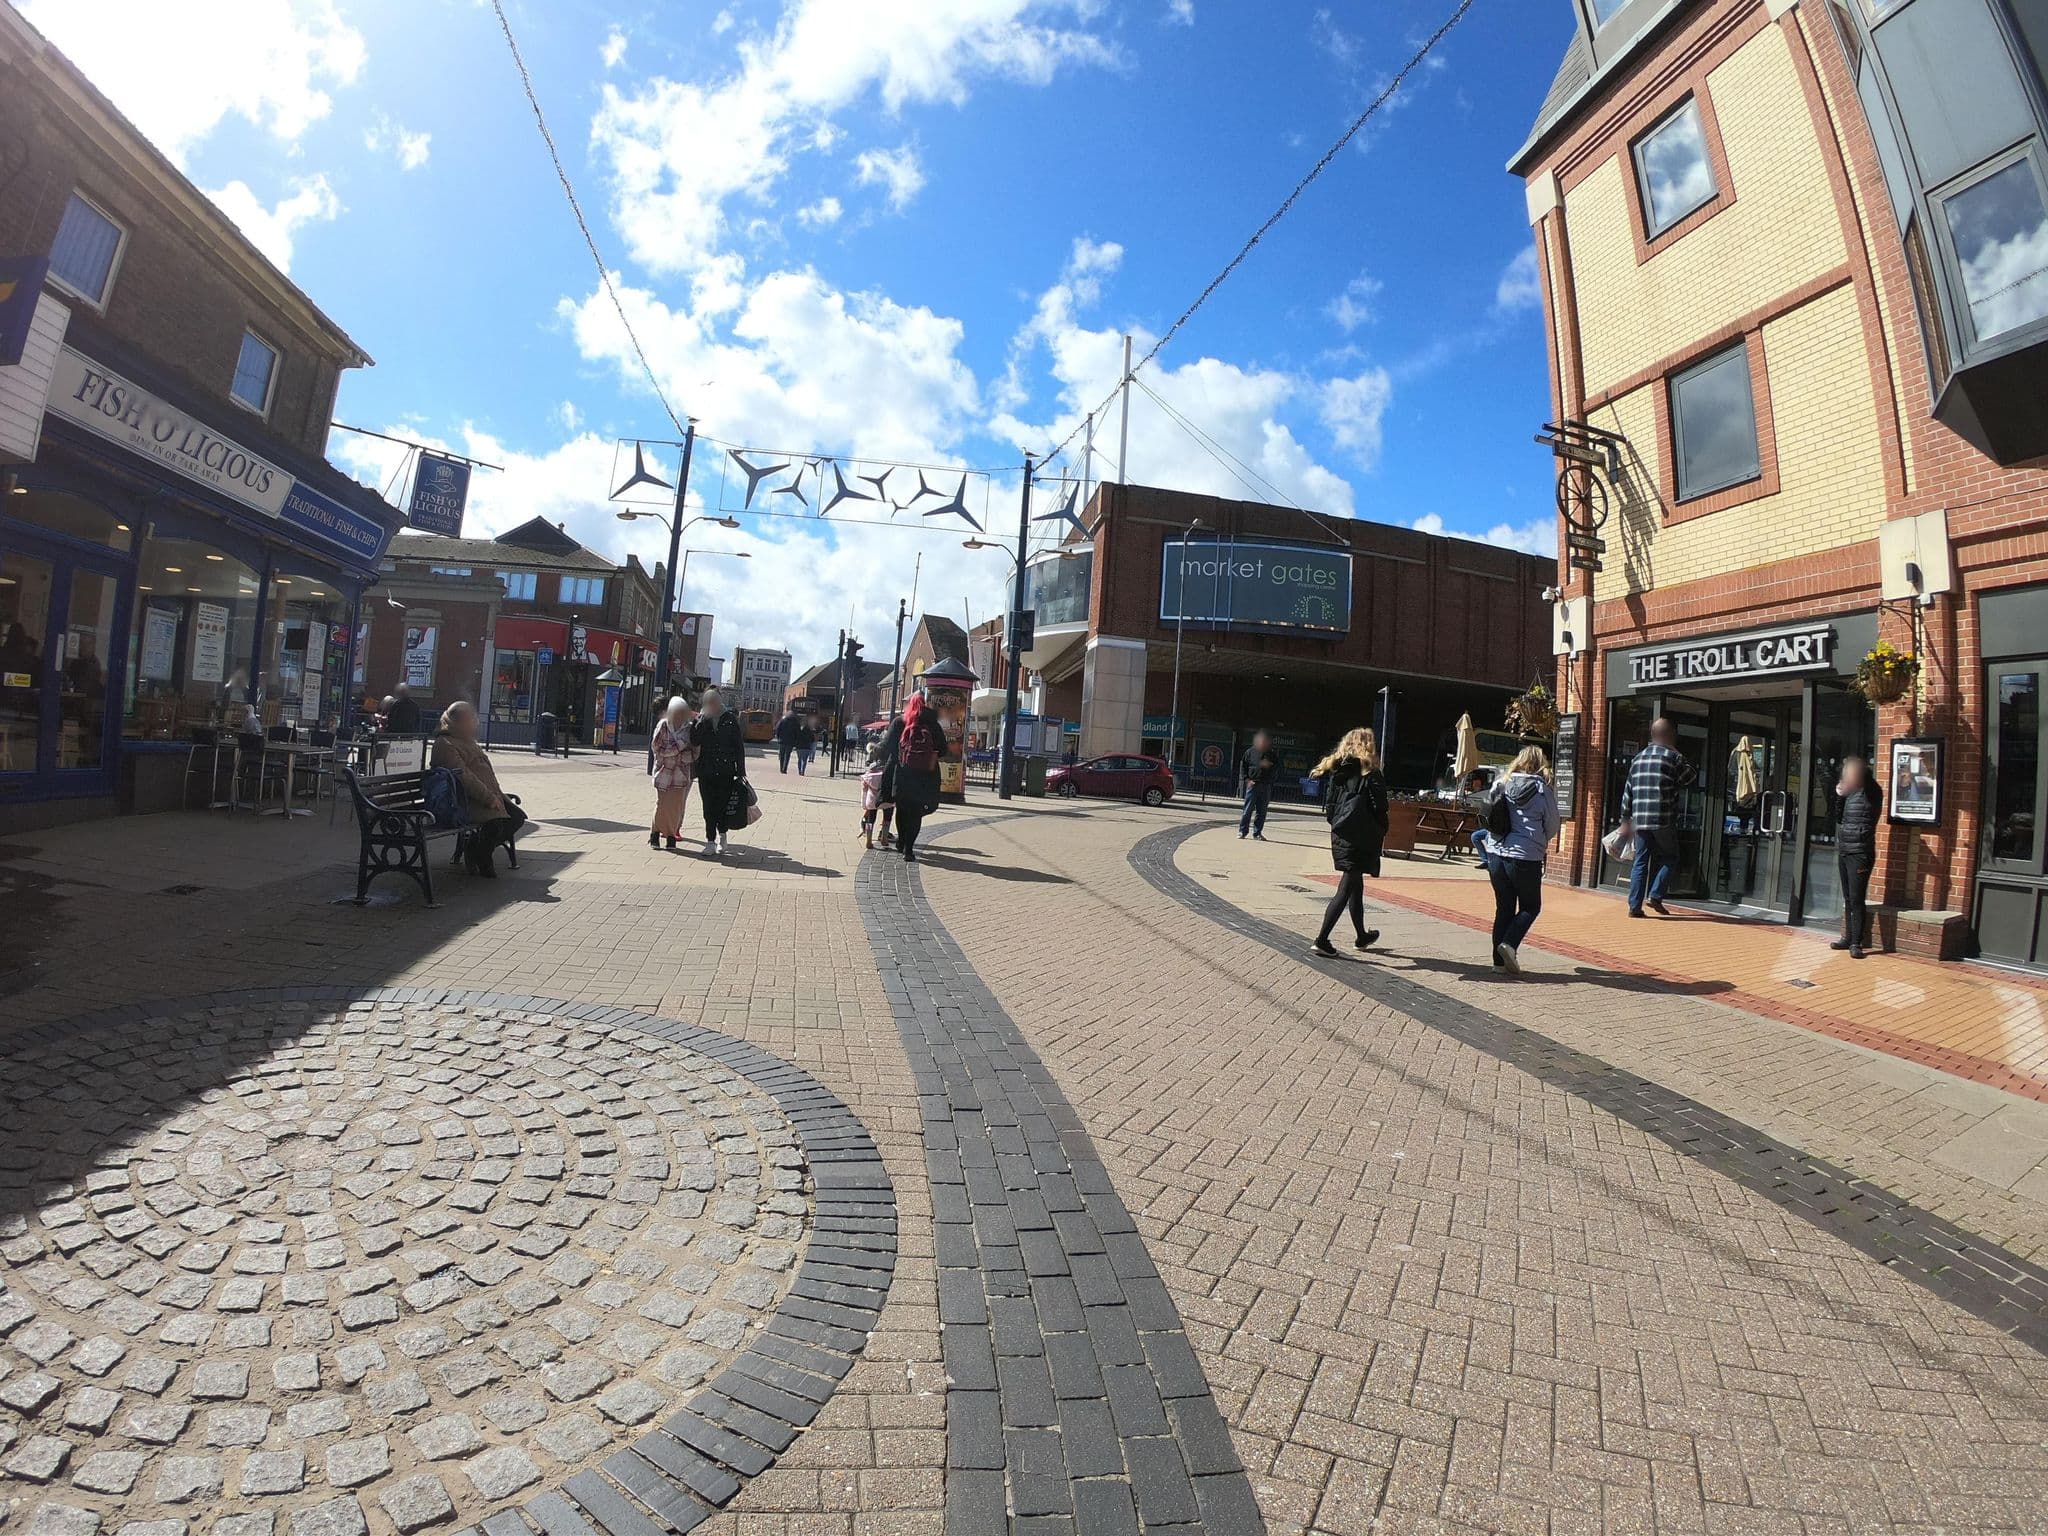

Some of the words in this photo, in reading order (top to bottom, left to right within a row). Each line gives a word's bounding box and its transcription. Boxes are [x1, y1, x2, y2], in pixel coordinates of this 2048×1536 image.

[287, 495, 335, 527] TRADITIONAL
[335, 519, 353, 536] FISH
[357, 530, 377, 548] CHIPS
[414, 500, 461, 519] LICIOUS
[1179, 557, 1264, 579] market
[1271, 564, 1337, 586] gates
[1629, 655, 1668, 681] THE
[1674, 644, 1750, 676] TROLL
[1755, 632, 1829, 667] CART
[1143, 721, 1168, 732] dland
